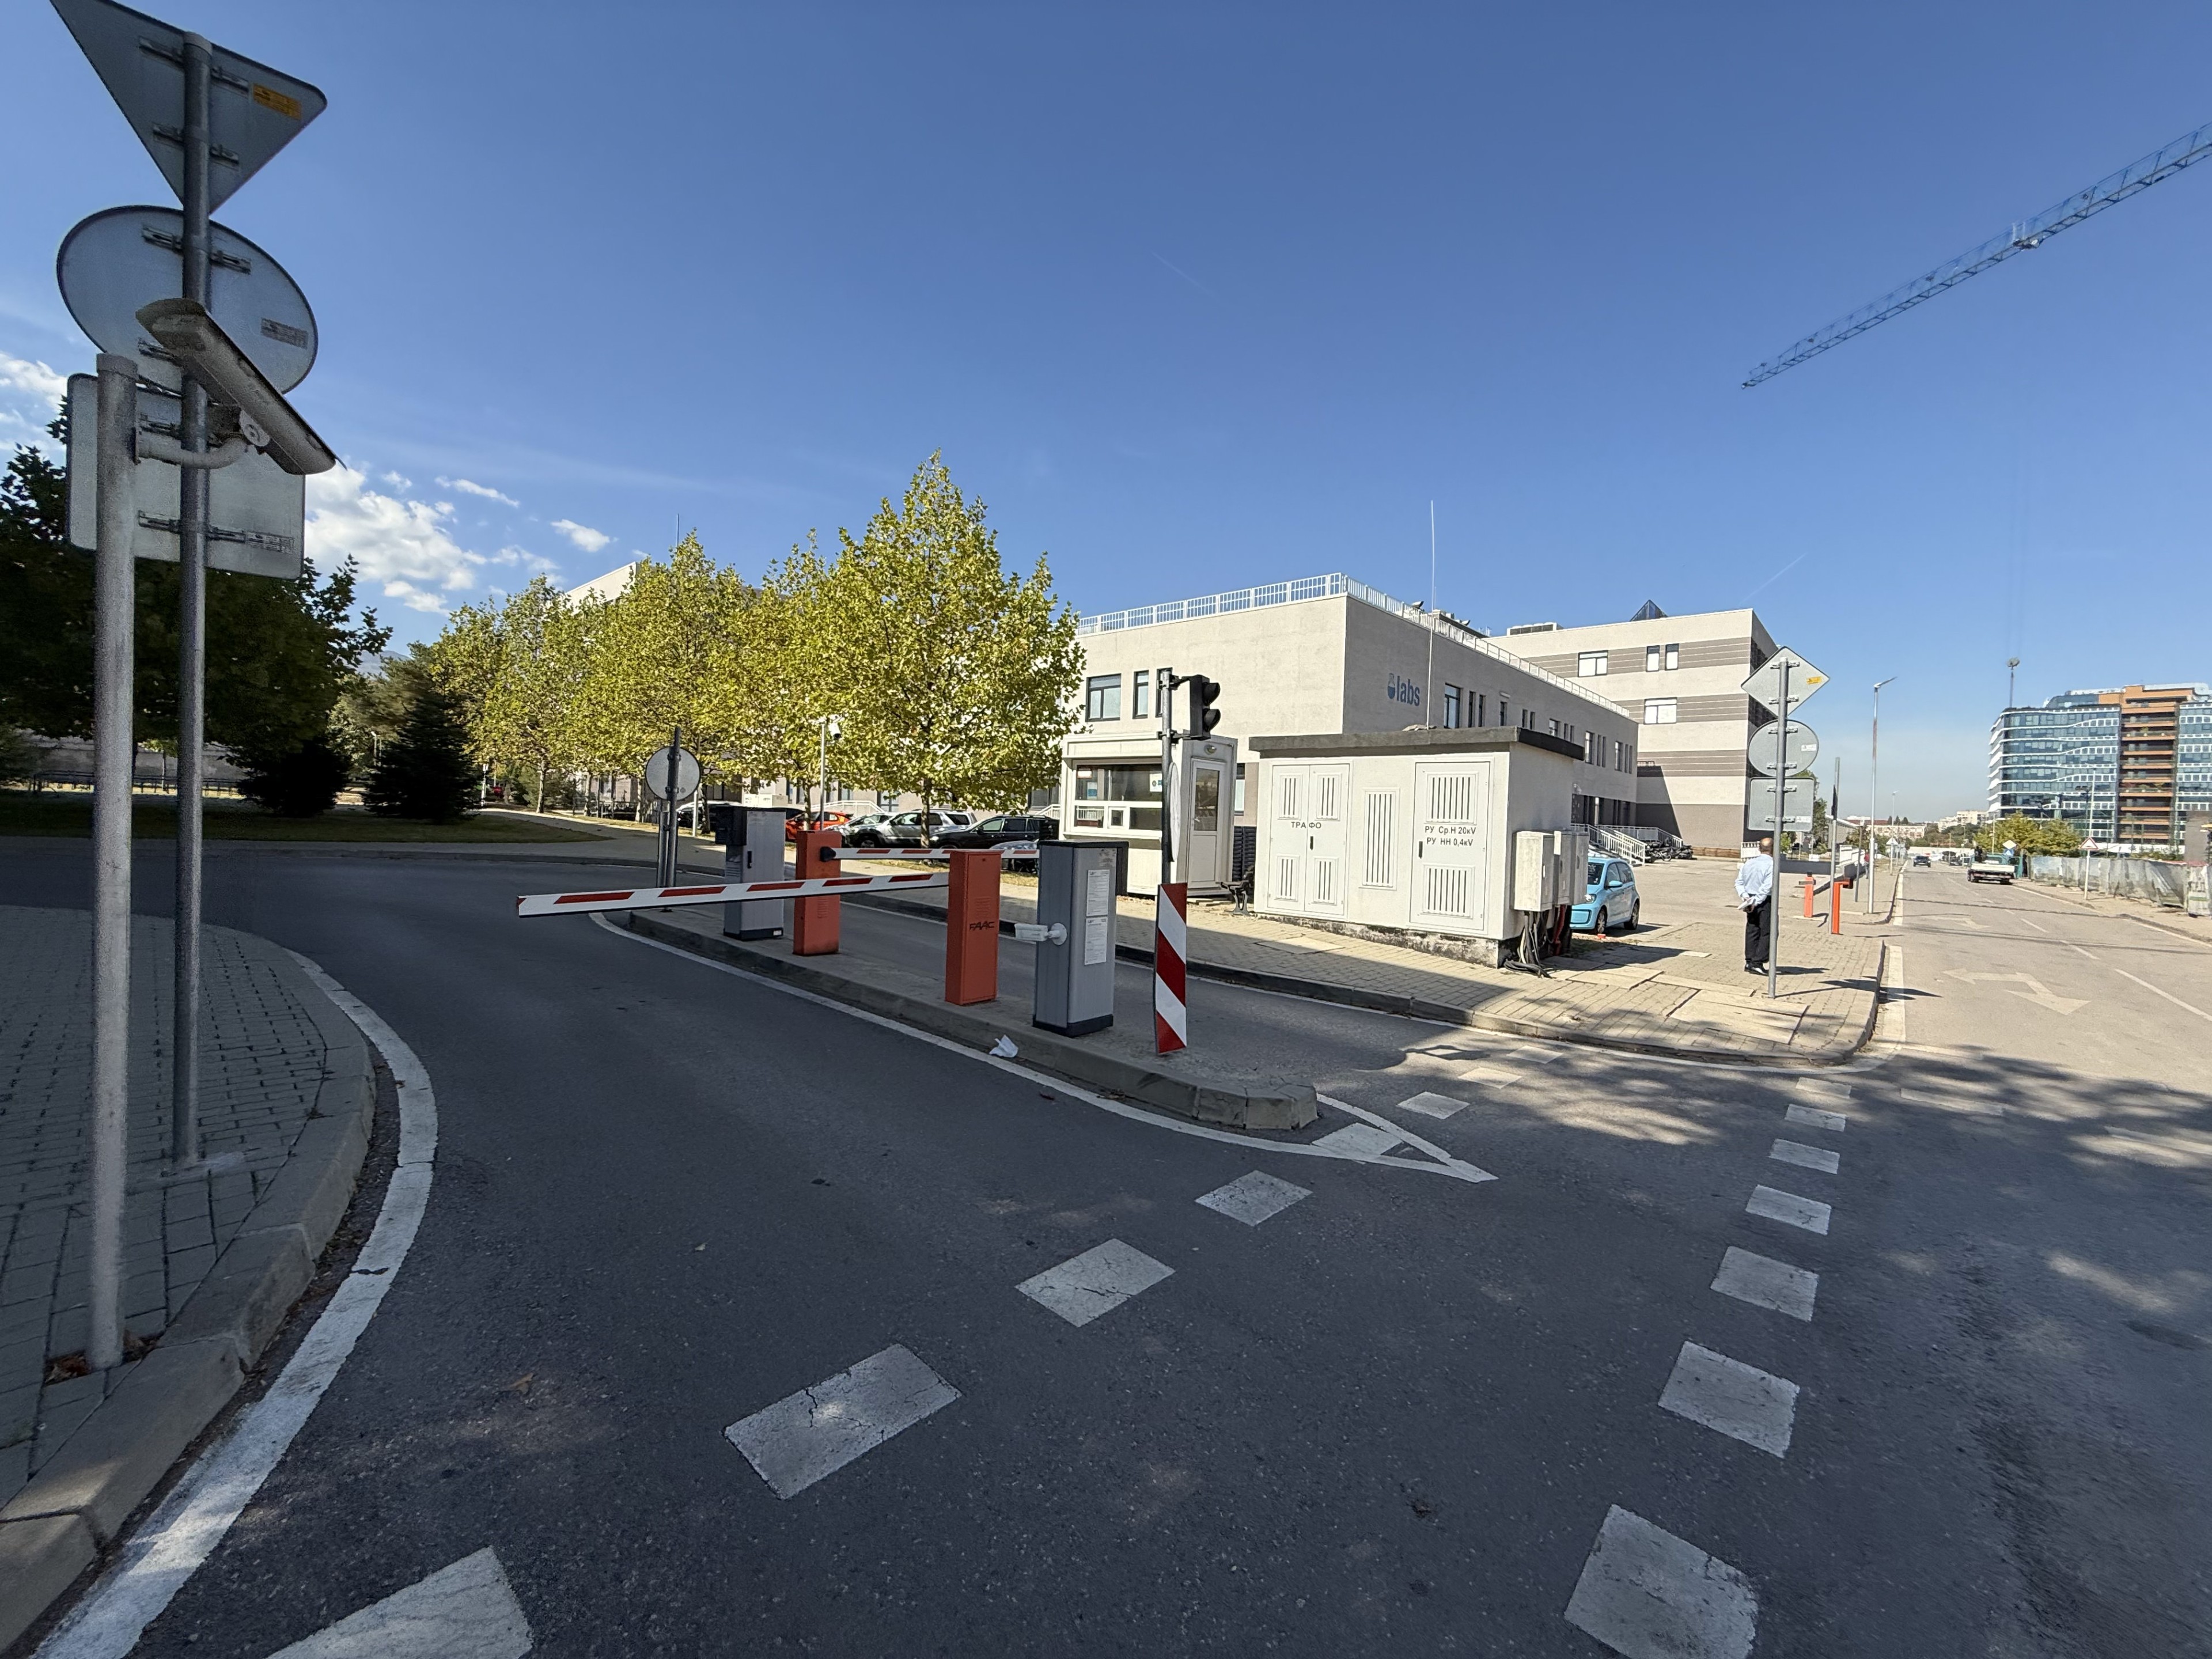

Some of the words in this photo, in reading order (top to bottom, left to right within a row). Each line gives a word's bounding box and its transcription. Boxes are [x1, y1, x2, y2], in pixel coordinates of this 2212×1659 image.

[1396, 675, 1420, 706] labs
[1426, 837, 1436, 845] РУ
[1440, 838, 1451, 846] НН
[969, 921, 995, 931] FAAC
